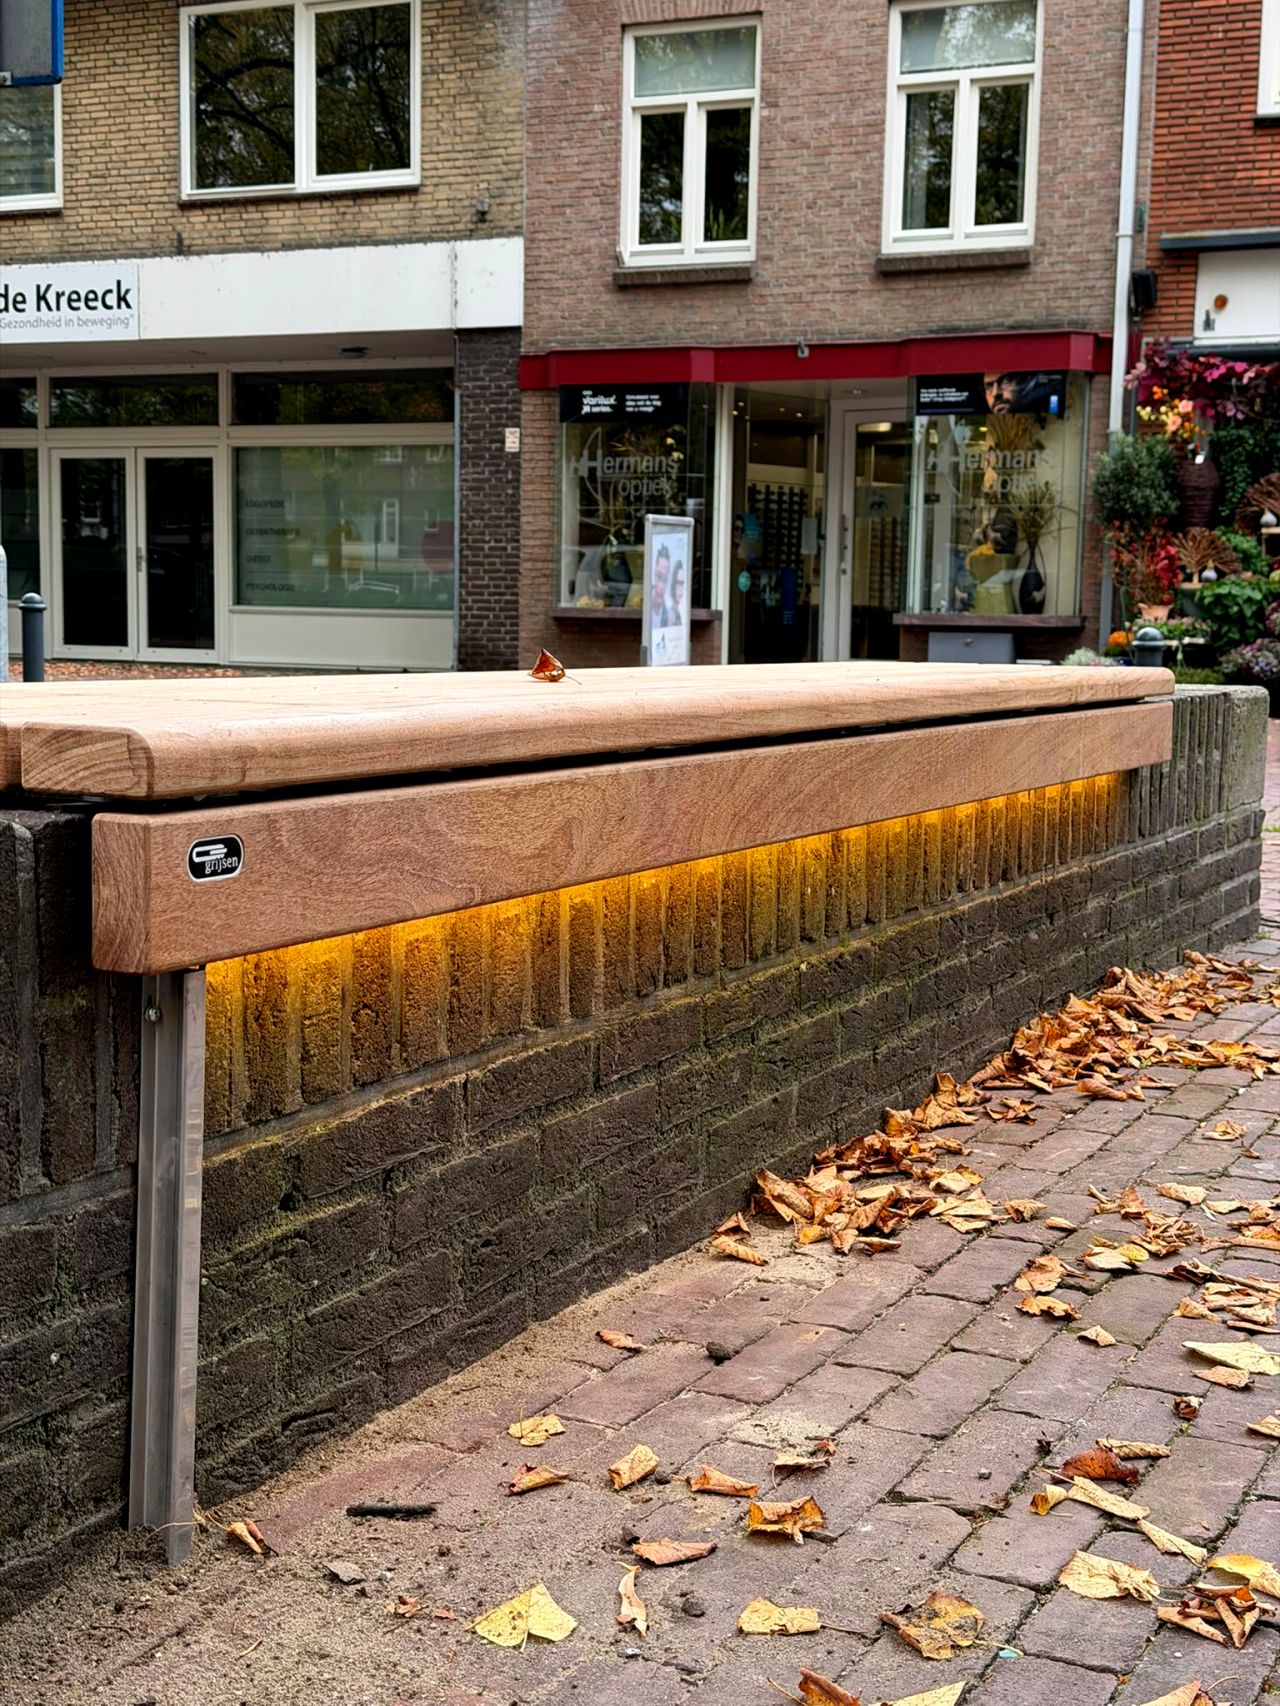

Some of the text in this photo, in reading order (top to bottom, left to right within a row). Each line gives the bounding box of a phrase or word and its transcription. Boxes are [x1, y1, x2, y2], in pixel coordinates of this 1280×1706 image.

[36, 279, 133, 312] Kreeck
[64, 317, 74, 327] in
[577, 448, 680, 478] Hermans
[618, 474, 673, 501] optiek
[204, 856, 238, 874] grijsen
